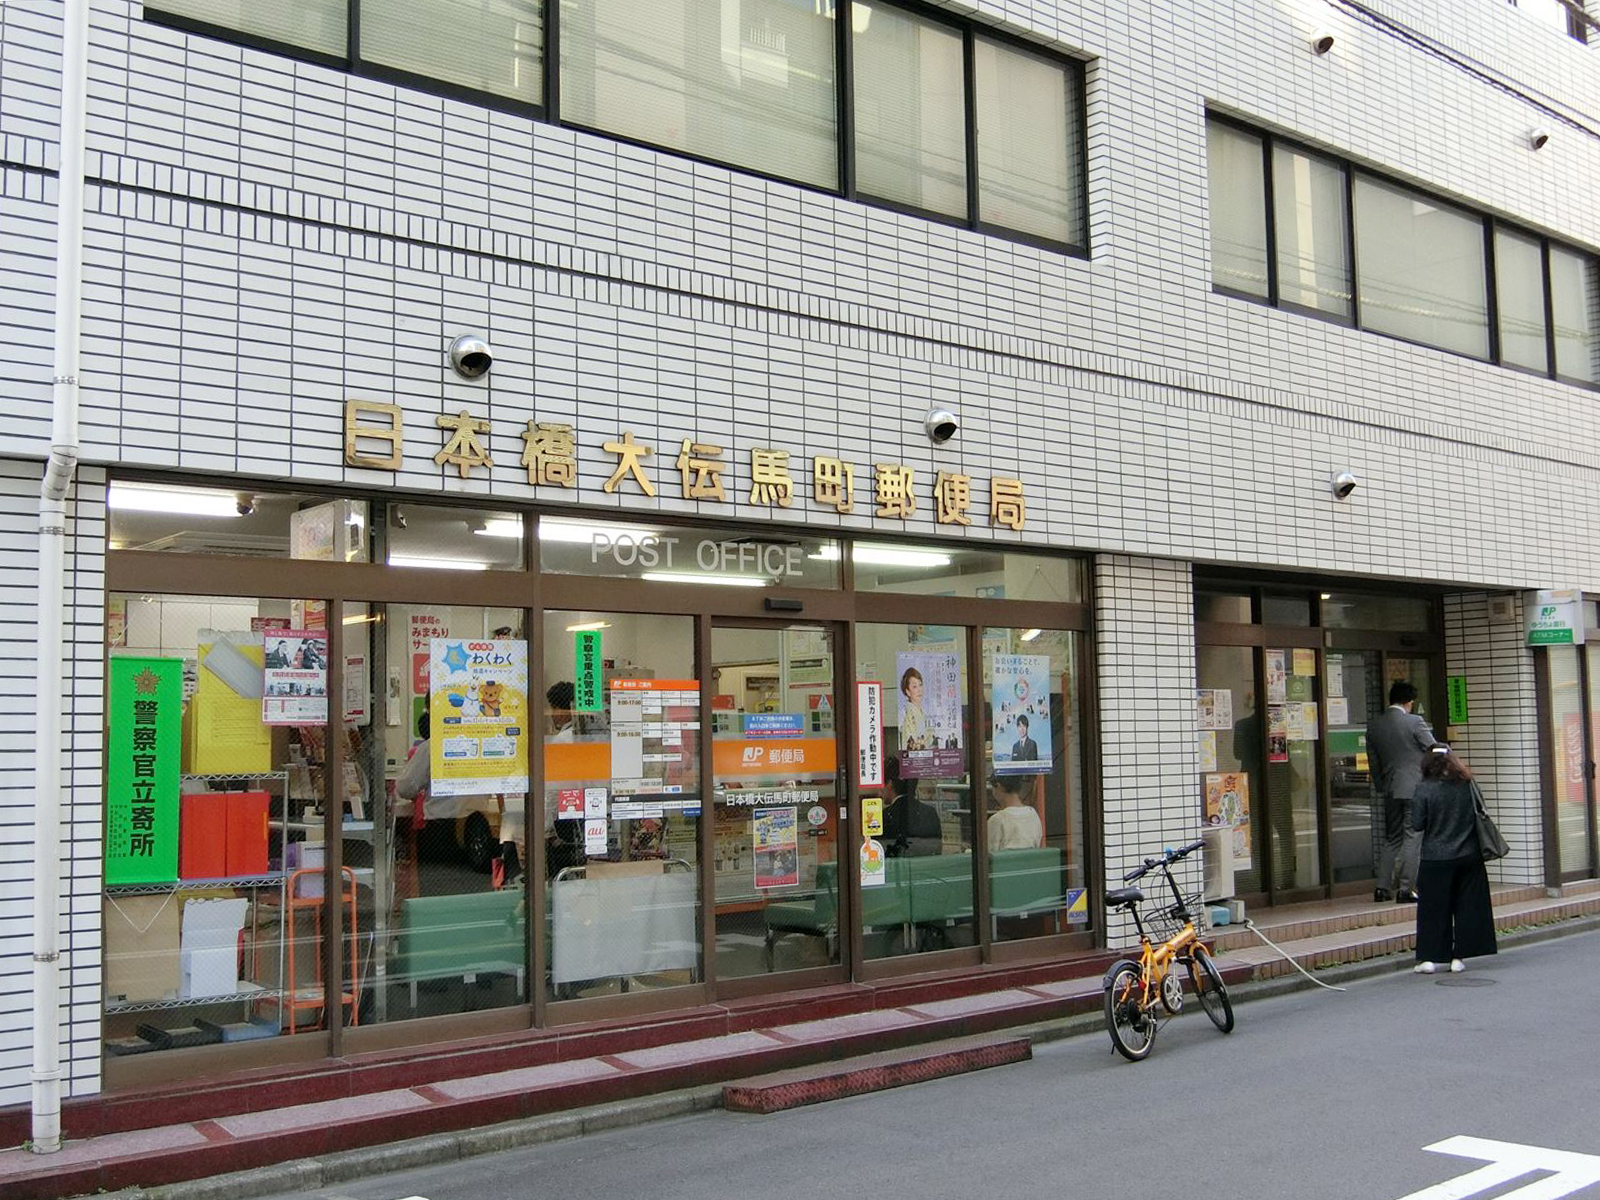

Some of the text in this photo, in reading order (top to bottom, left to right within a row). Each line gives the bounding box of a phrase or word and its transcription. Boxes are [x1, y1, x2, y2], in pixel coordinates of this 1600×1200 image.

[344, 399, 1026, 531] 日本橋大伝馬町郵便局
[592, 532, 804, 576] POST OFFICE
[411, 627, 449, 638] みまもり
[472, 652, 512, 665] わくわく
[768, 748, 805, 763] 郵便局
[130, 700, 158, 857] 警察官立寄所
[726, 791, 819, 807] 日本橋大伝馬町郵便局
[588, 827, 604, 836] au
